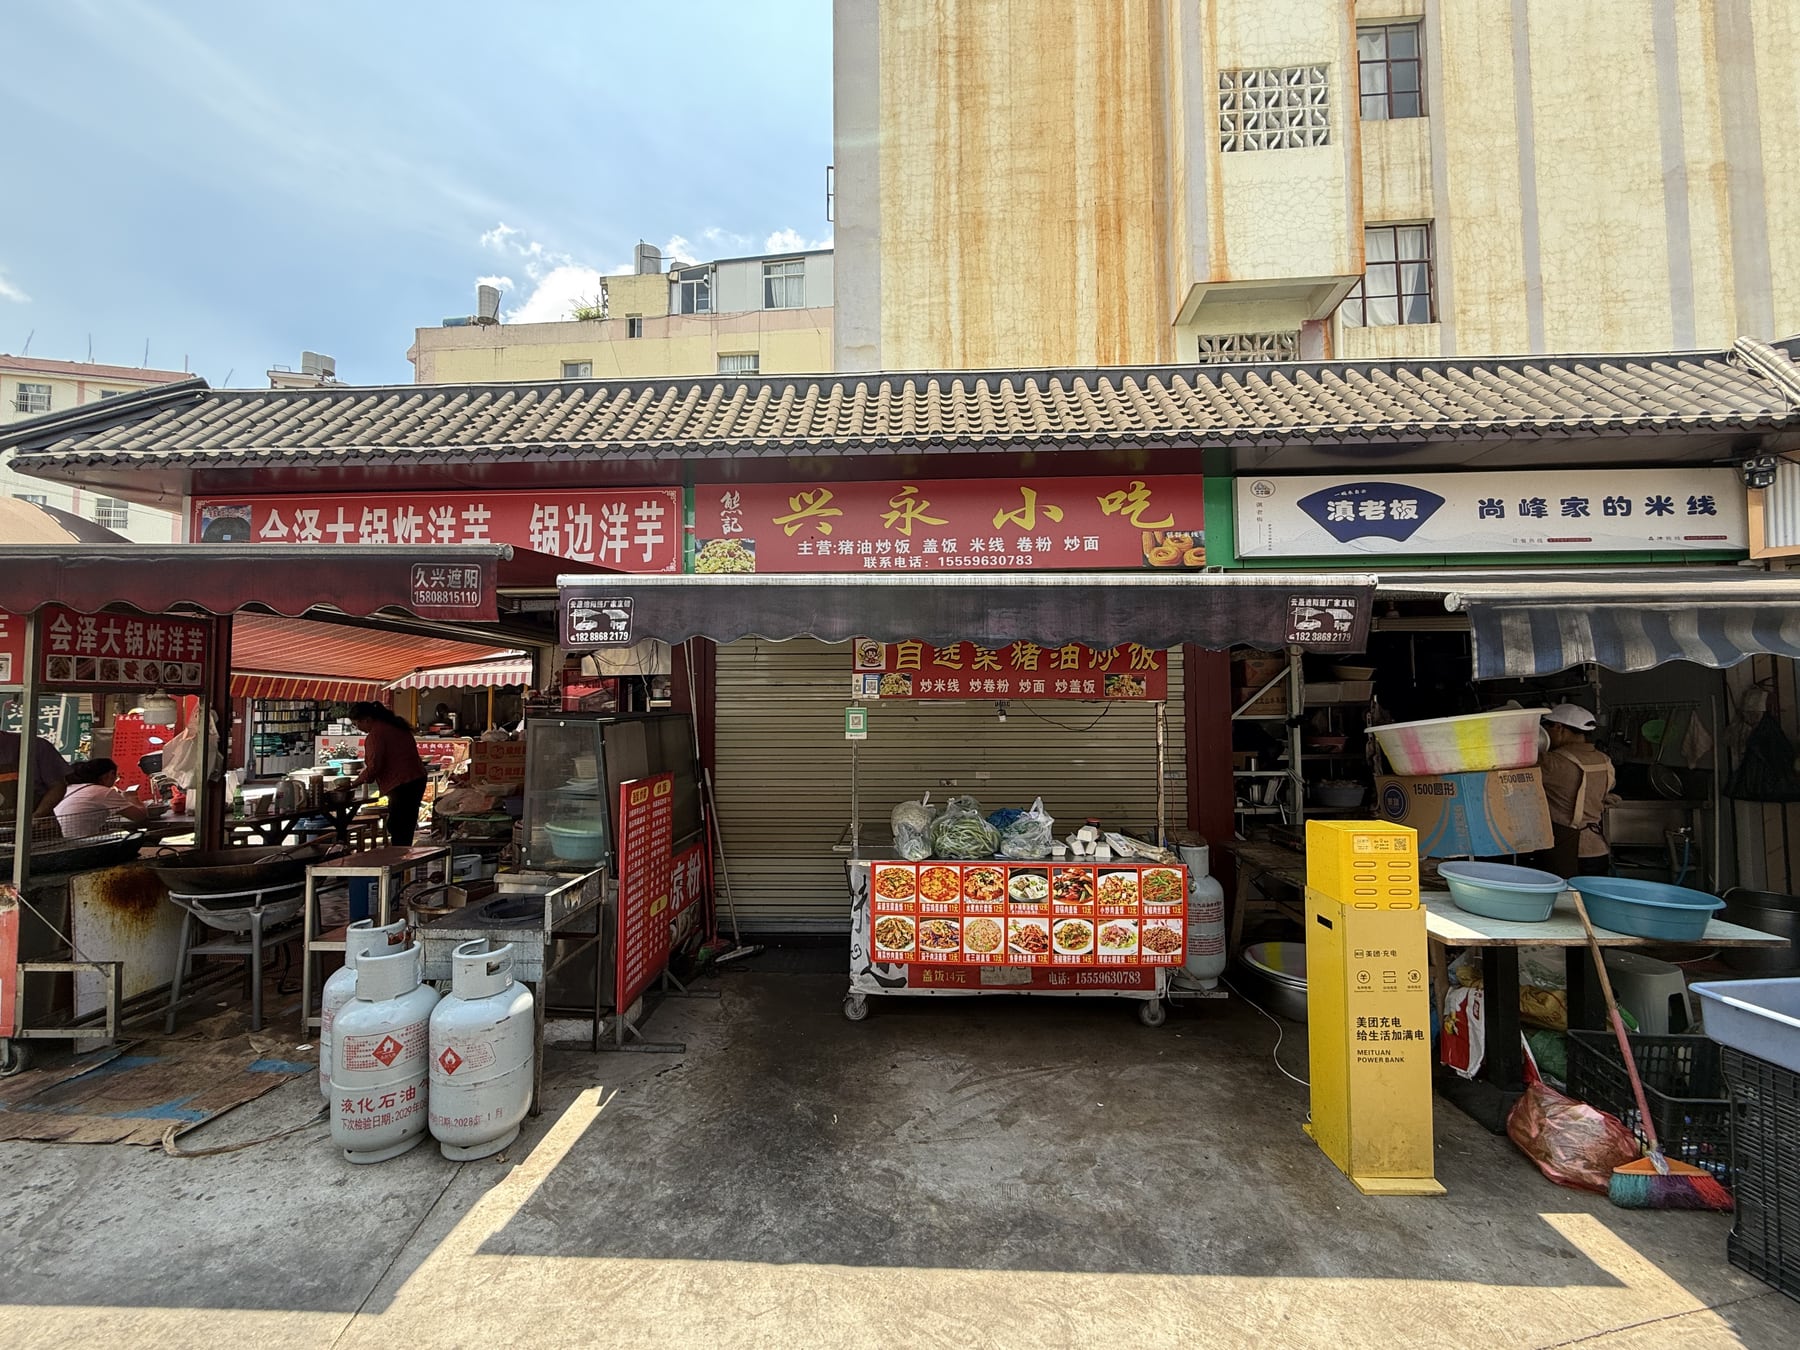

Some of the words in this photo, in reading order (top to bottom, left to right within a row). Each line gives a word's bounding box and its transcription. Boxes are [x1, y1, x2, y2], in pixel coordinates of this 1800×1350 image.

[772, 481, 1174, 536] 兴永小吃
[1327, 499, 1419, 521] 滇老板
[1478, 495, 1717, 519] 尚峰家的米线
[259, 504, 491, 544] 会泽大锅炸洋芋
[529, 500, 665, 563] 锅边洋芋
[797, 539, 910, 556] 主营:猪油炒饭
[922, 538, 957, 554] 盖饭
[970, 537, 1005, 553] 米线
[1017, 536, 1052, 552] 卷粉
[1064, 536, 1099, 551] 炒面
[863, 557, 929, 569] 联系电话:
[938, 556, 1032, 567] 15559630783
[415, 568, 479, 589] 久兴遮阳
[414, 591, 478, 604] 15808815110
[50, 613, 204, 660] 会泽大锅炸洋芋
[576, 632, 589, 641] 182
[610, 631, 628, 641] 2179
[1296, 632, 1310, 641] 182
[896, 640, 1160, 671] 自选菜猪油炒饭
[920, 679, 960, 693] 炒米线
[969, 679, 1009, 693] 炒卷粉
[1019, 679, 1046, 693] 炒面
[1055, 679, 1095, 693] 炒盖饭
[1499, 773, 1535, 785] 1500圆形
[1413, 782, 1455, 796] 1500圆形
[922, 969, 966, 984] 盖饭14元
[1049, 972, 1070, 985] 电话:
[1076, 971, 1141, 984] 15559630783
[1356, 1016, 1402, 1028] 美团充电
[1356, 1029, 1425, 1041] 给生活加满电
